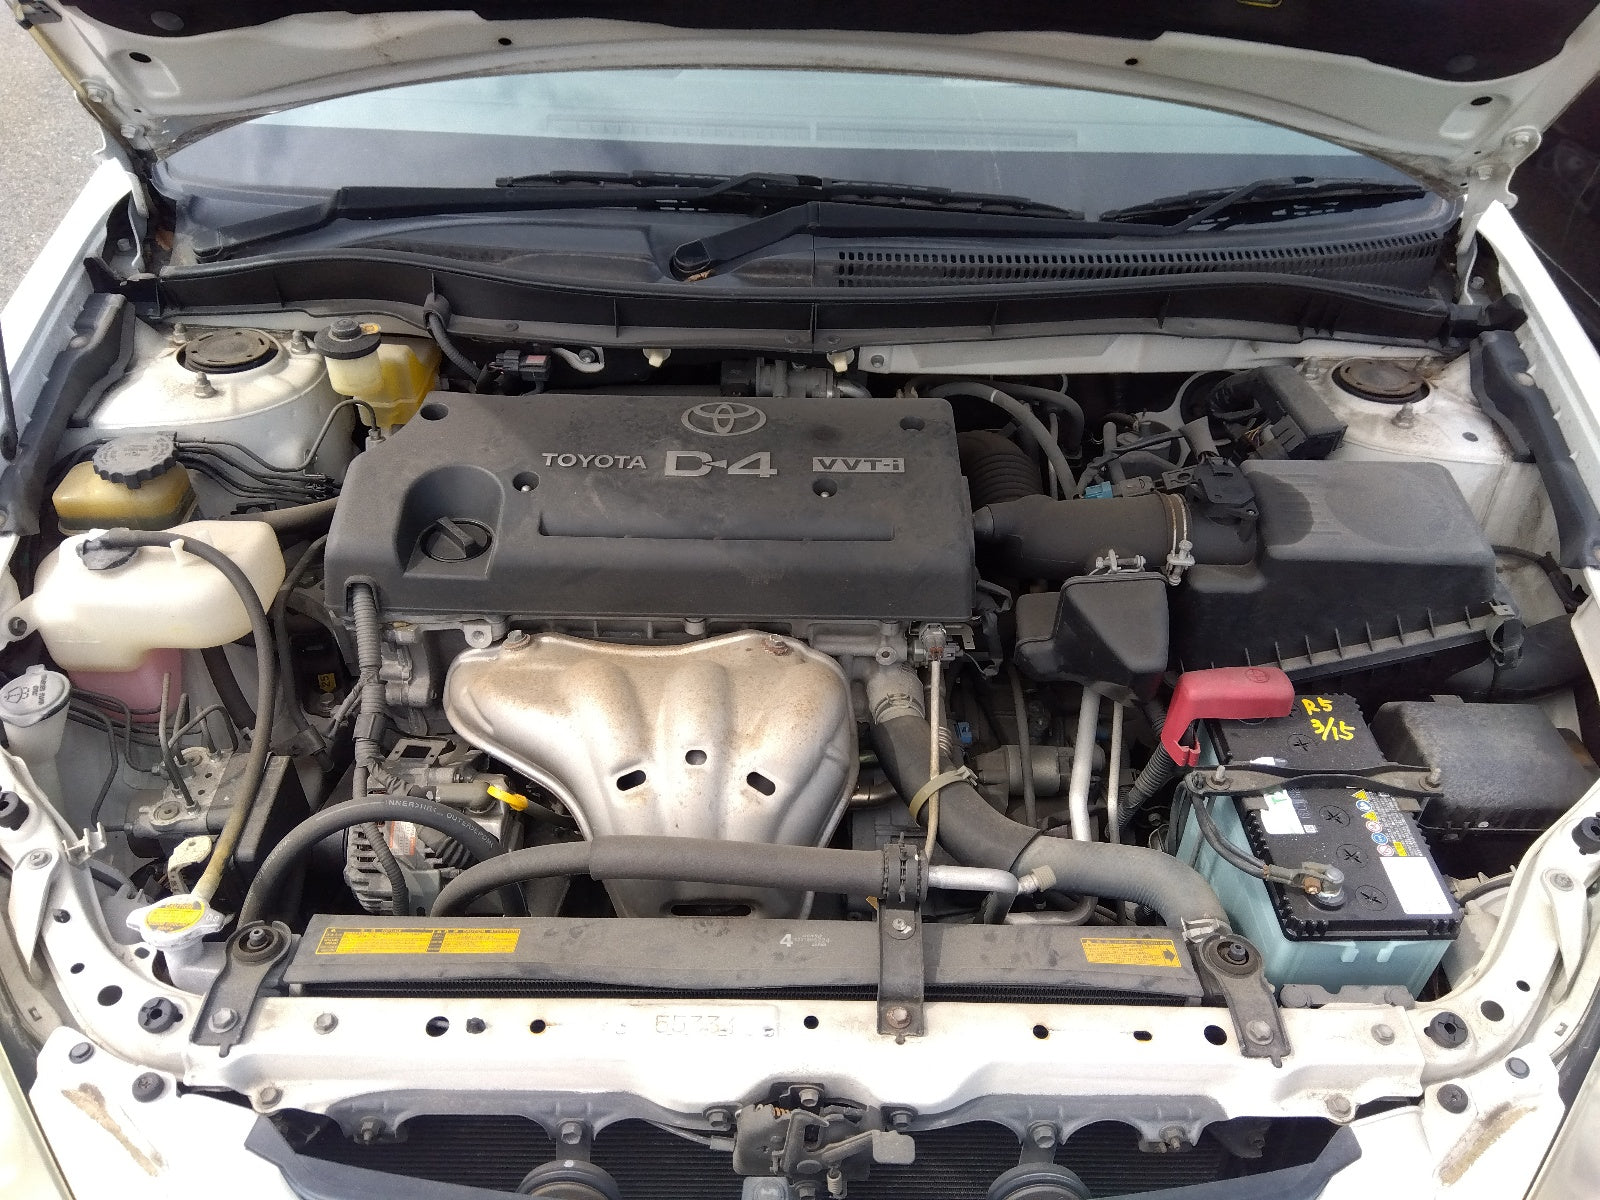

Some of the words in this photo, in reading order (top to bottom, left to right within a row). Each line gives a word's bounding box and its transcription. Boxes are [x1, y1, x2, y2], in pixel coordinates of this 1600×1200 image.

[541, 452, 647, 469] TOYOTA
[665, 450, 777, 478] D-4
[813, 457, 905, 473] VVT-i
[1310, 716, 1356, 741] 3/15
[780, 933, 794, 948] 4
